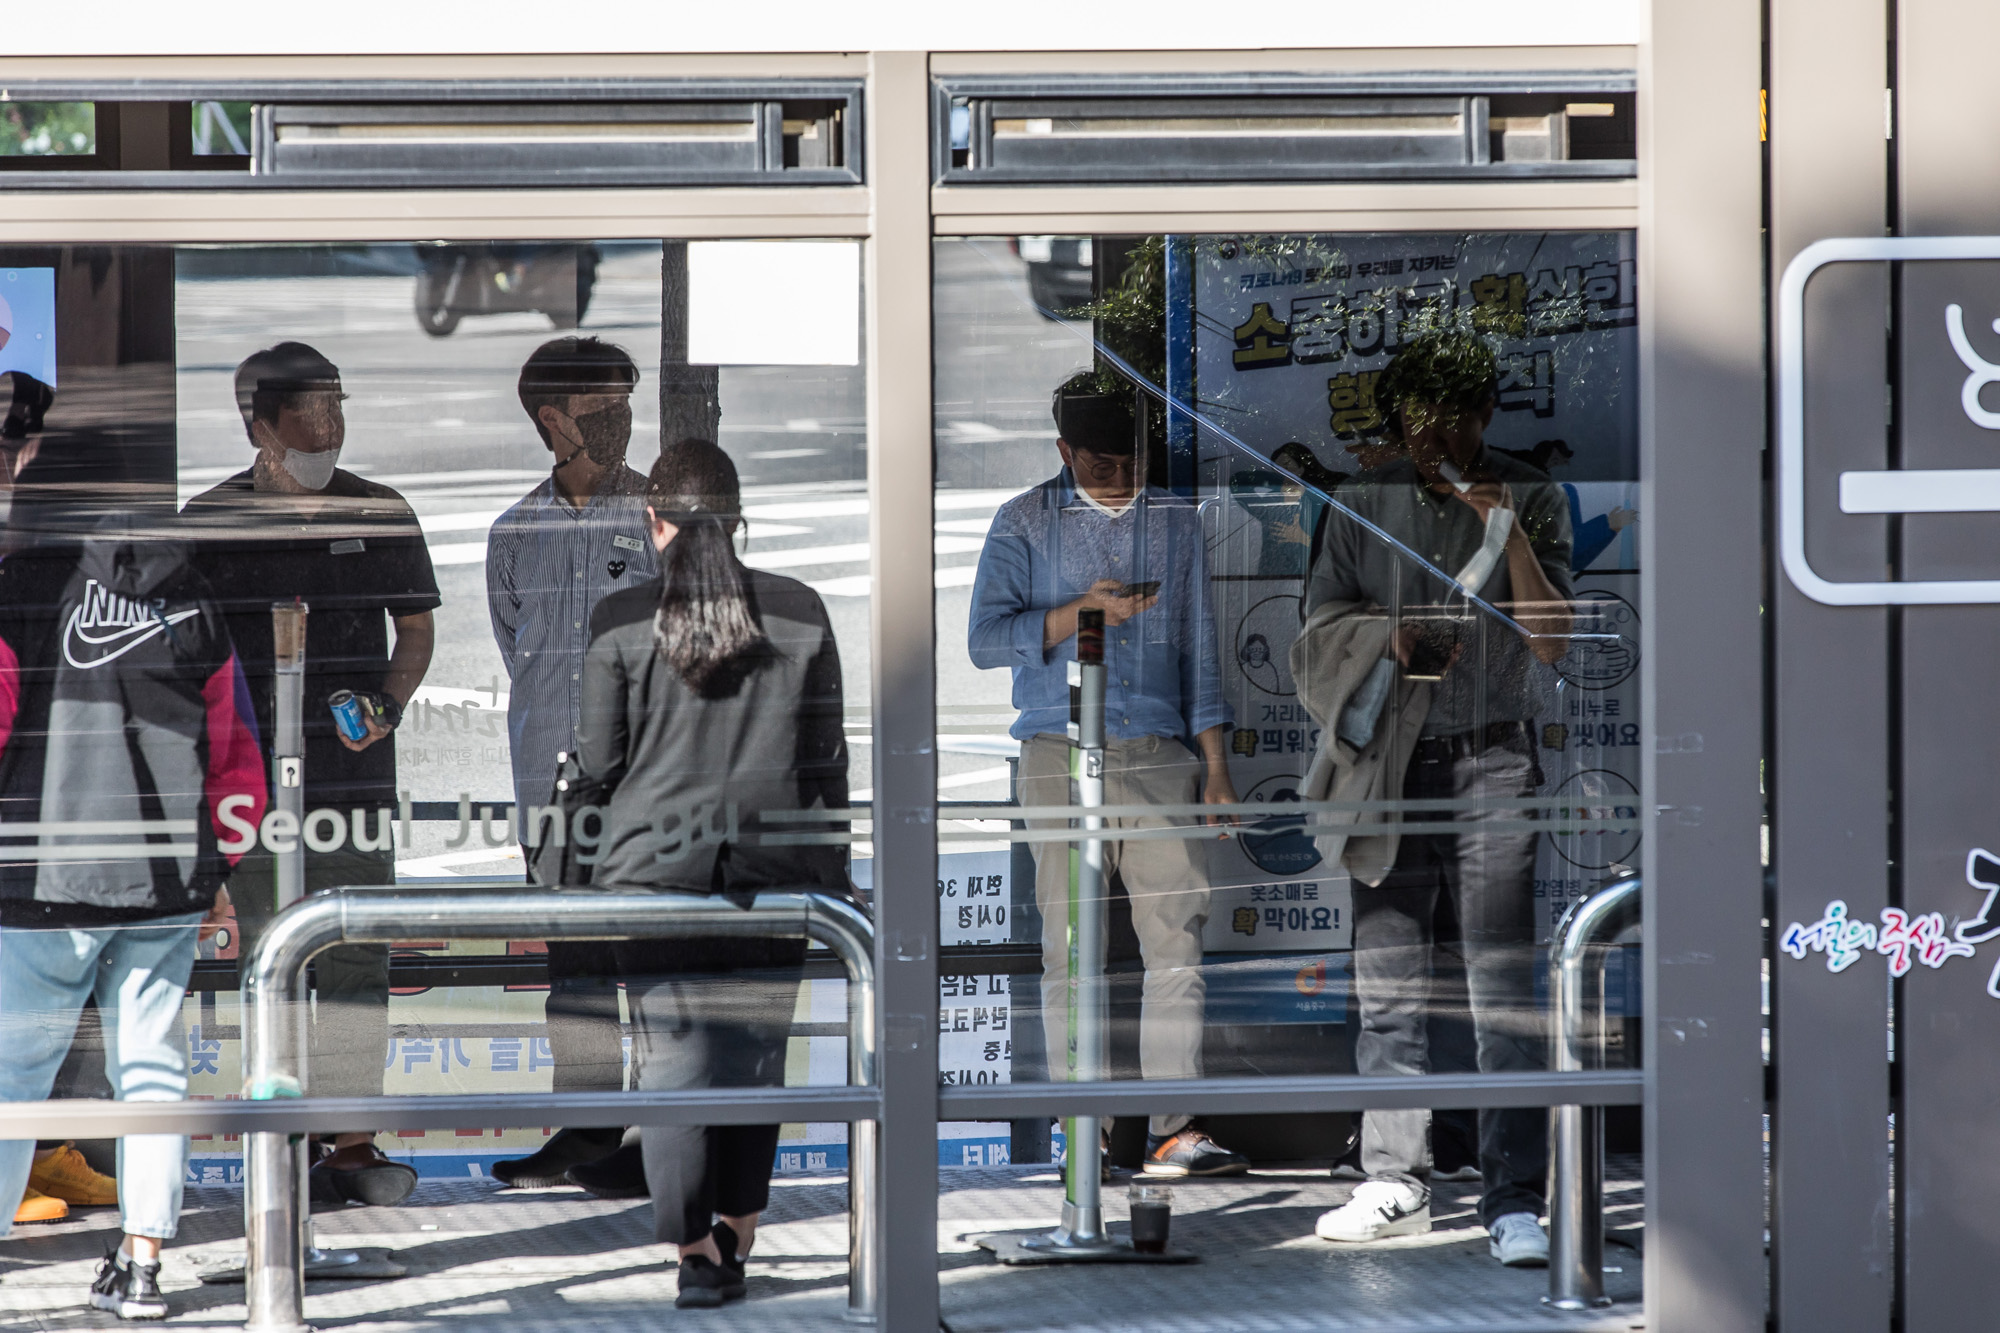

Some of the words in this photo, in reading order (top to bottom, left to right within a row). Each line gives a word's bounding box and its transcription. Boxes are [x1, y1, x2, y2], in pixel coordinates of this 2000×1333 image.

[1407, 255, 1457, 274] 지키는
[1261, 704, 1311, 722] 거리를
[1570, 698, 1621, 717] 비누로
[216, 791, 411, 855] Seoul
[446, 791, 612, 866] Jung
[1250, 883, 1319, 902] 옷소매로
[1264, 906, 1341, 933] 막아요!
[1780, 899, 1878, 974] 서울의
[1876, 907, 1976, 978] 중심
